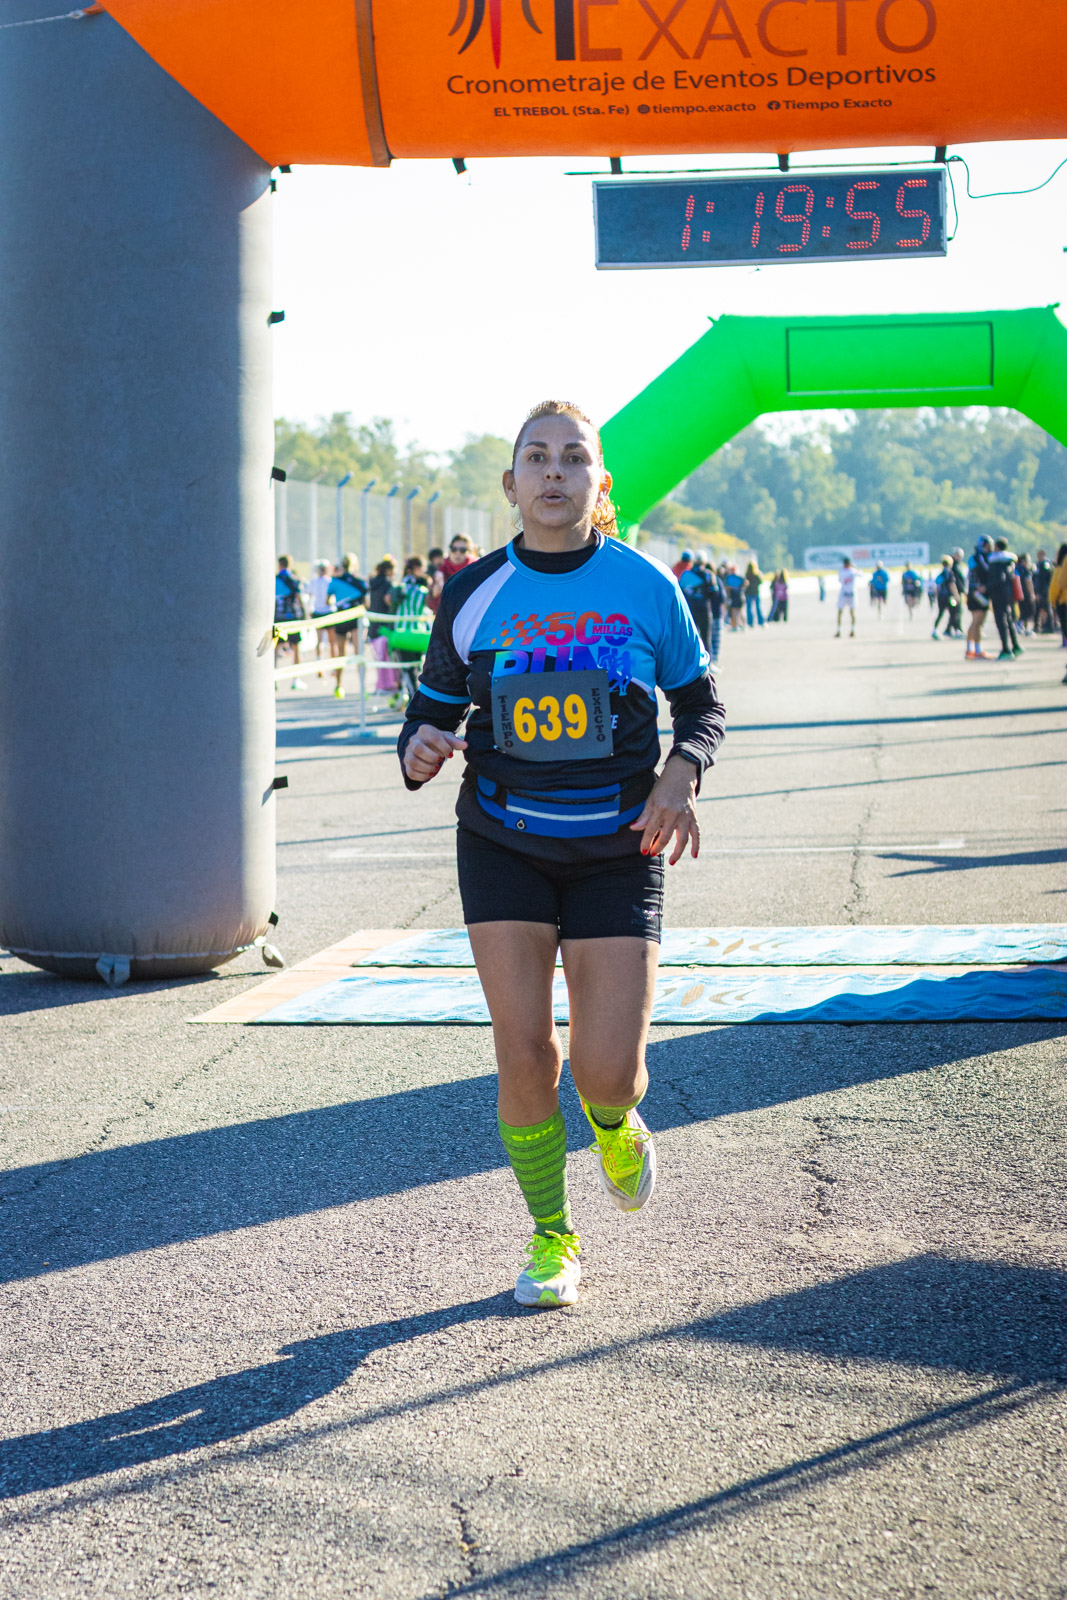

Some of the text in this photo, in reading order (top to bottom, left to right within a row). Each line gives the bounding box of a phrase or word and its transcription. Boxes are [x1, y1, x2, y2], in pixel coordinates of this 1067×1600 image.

[447, 65, 936, 96] Cronometraje de Eventos Deportivos
[494, 98, 892, 117] EL TREBOL (Sta. Fe) tiempo.exacto Tiempo Exacto
[592, 624, 633, 637] MILLAS
[498, 695, 514, 748] TIEMPO
[513, 694, 587, 743] 639
[591, 687, 606, 742] EXACTO
